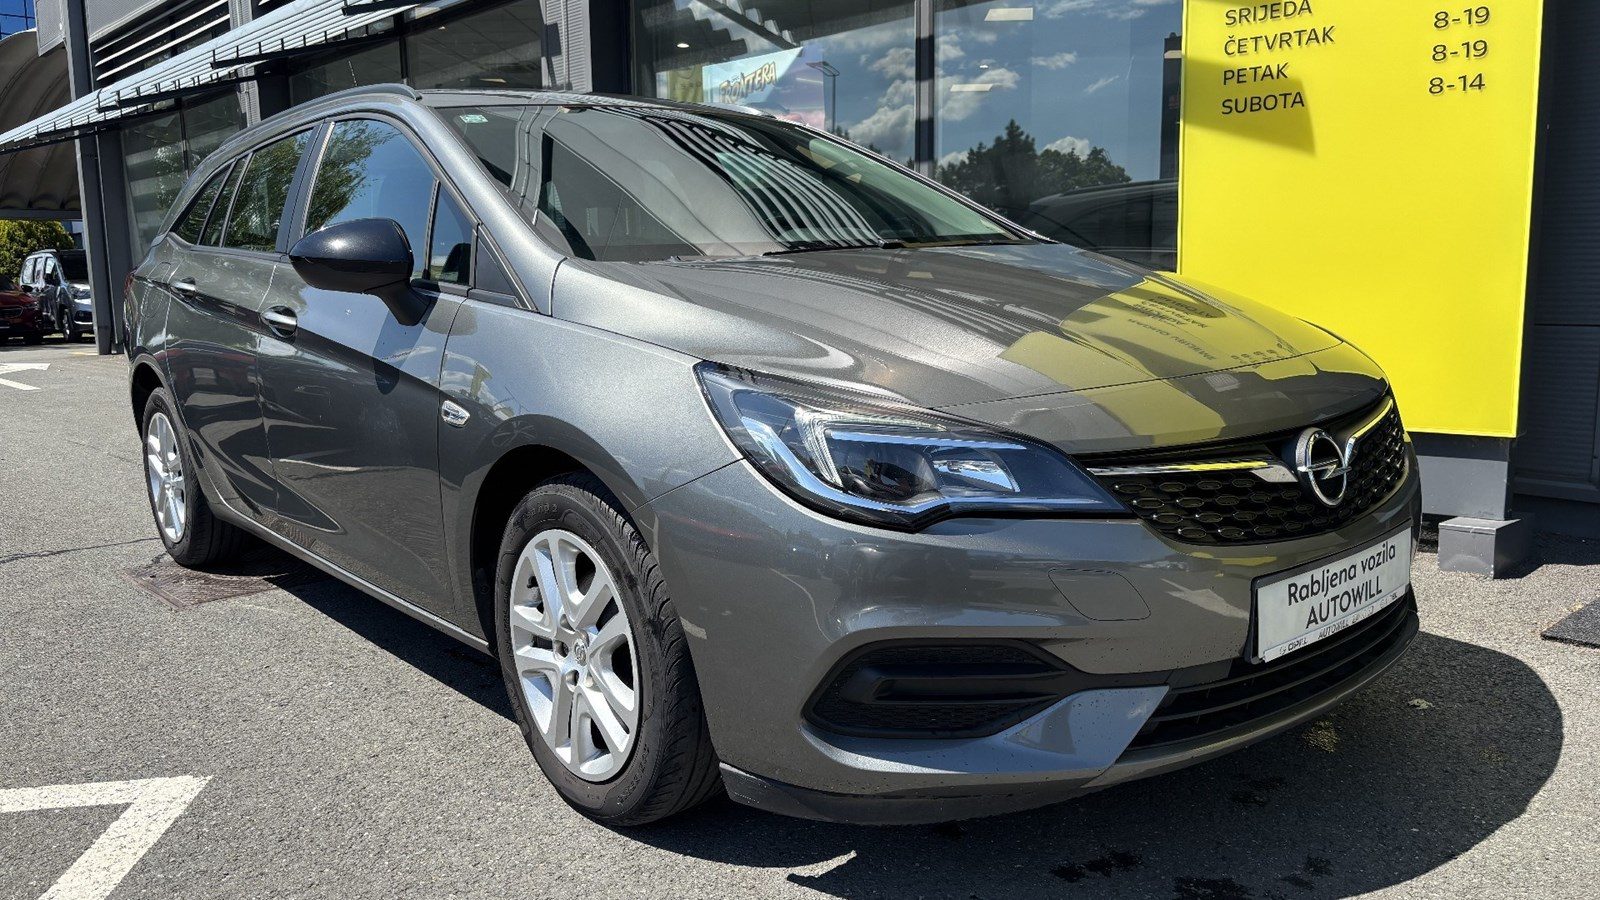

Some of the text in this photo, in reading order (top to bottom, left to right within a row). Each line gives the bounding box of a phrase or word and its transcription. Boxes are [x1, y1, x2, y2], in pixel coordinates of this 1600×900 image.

[1224, 6, 1490, 56] ČETVRTAK 8-19
[1225, 0, 1312, 26] SRIJEDA
[719, 61, 778, 104] FRONTERA
[1223, 39, 1488, 85] PETAK 8-19
[1221, 73, 1486, 115] SUBOTA 8-14
[1287, 562, 1357, 606] Rabljena
[1360, 541, 1396, 574] vozila
[1306, 576, 1383, 629] AUTOWILL
